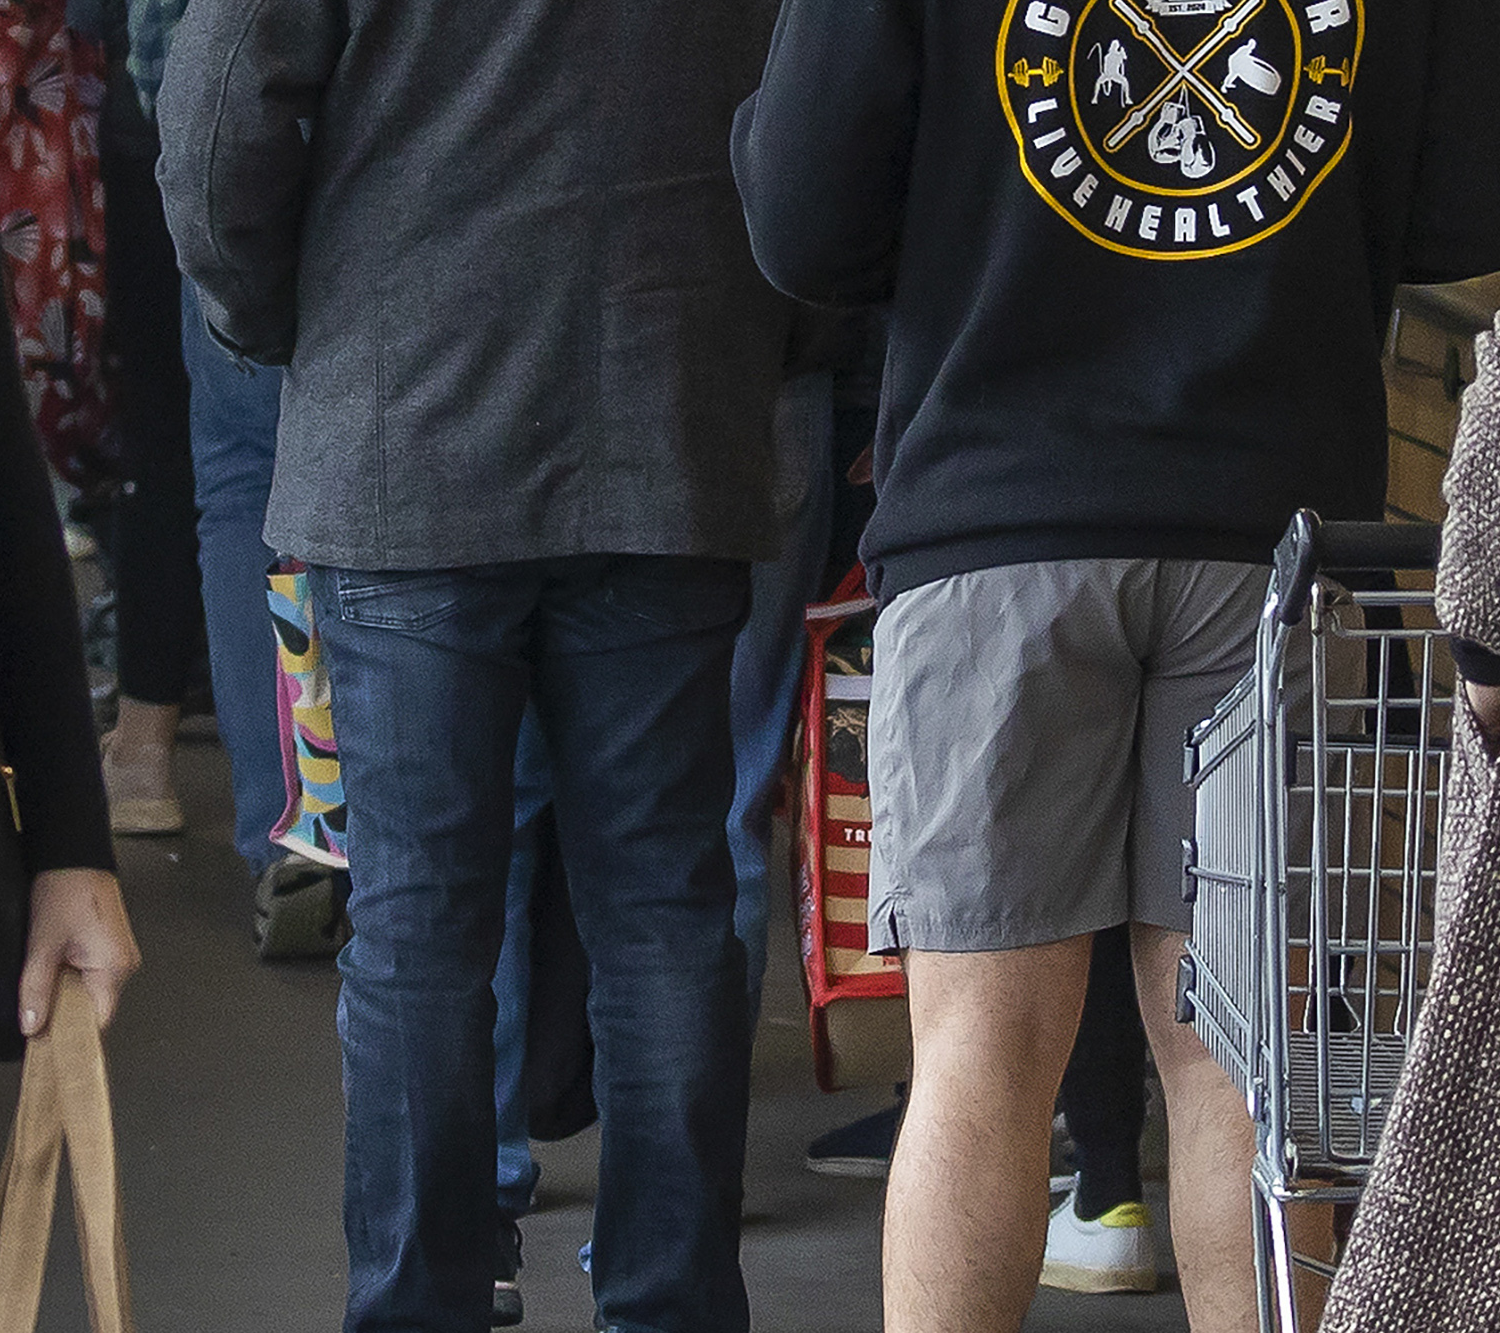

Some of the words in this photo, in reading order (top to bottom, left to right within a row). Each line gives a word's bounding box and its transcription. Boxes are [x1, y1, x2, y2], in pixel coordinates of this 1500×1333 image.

[1026, 96, 1099, 209] LIVE
[1104, 94, 1343, 243] HEALTHIER
[843, 827, 872, 843] TR
